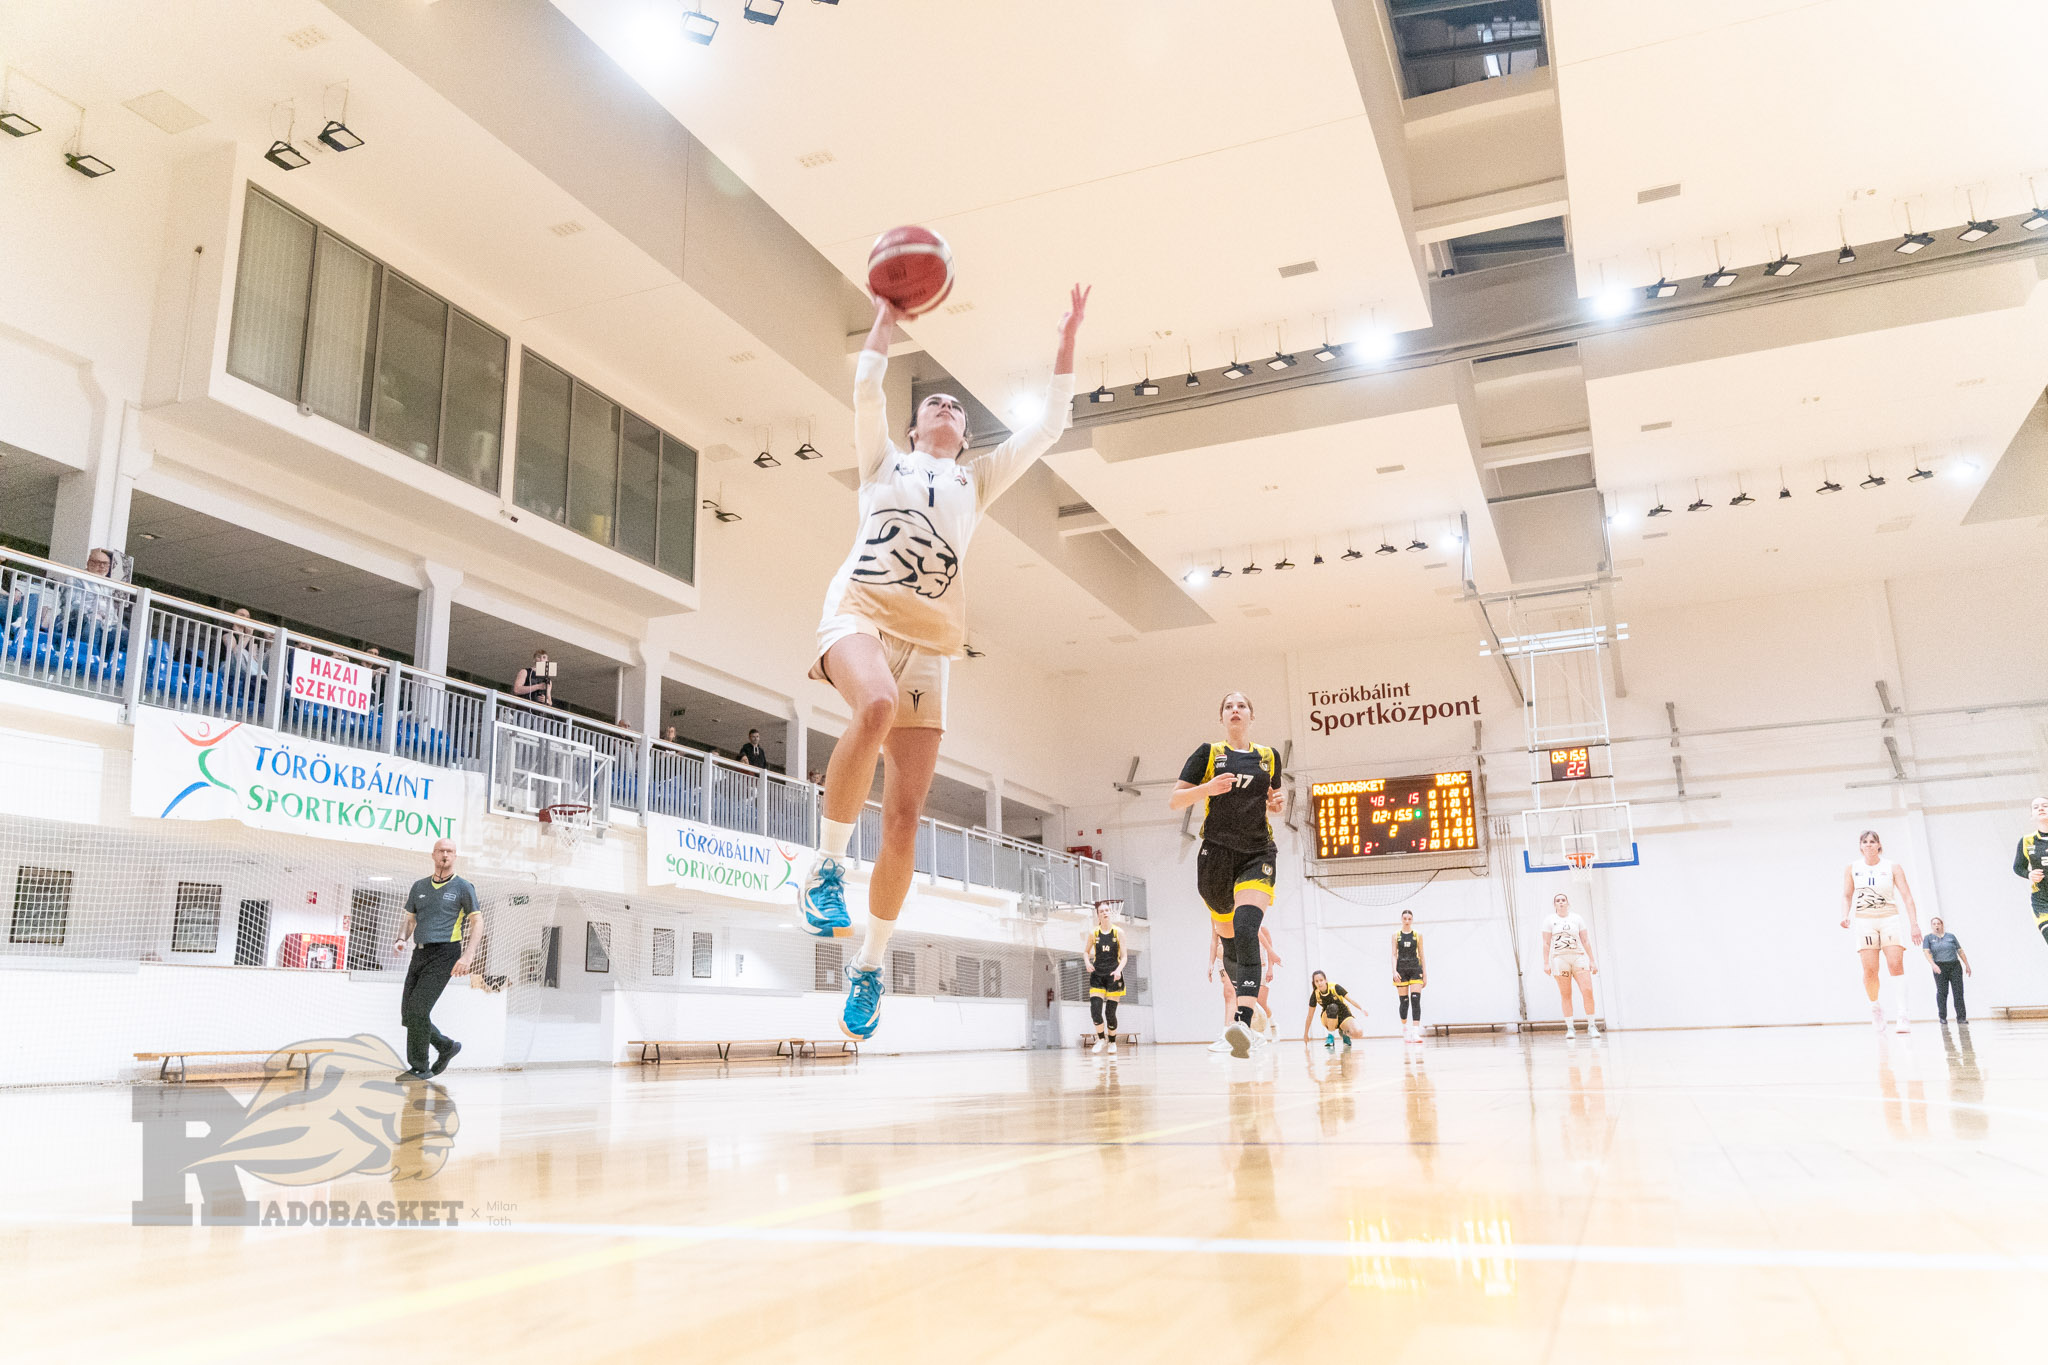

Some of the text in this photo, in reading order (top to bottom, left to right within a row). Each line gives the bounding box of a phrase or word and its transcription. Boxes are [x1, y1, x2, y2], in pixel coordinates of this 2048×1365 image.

[928, 487, 935, 507] 1
[310, 657, 358, 686] HAZAI
[295, 676, 368, 710] SZEKTOR
[1308, 682, 1411, 706] Törökbálint
[1310, 695, 1481, 736] Sportközpont
[254, 744, 434, 800] TÖRÖKBÁLINT
[1435, 772, 1468, 787] BEAC
[1566, 760, 1587, 777] 22
[1236, 773, 1254, 789] 17
[1313, 779, 1386, 796] RADOBASKET
[1370, 795, 1385, 807] 48
[1408, 792, 1419, 805] 15
[247, 784, 457, 839] SPORTKÖZPONT
[1389, 824, 1399, 838] 2
[676, 828, 771, 865] TÖRÖKBÁLINT
